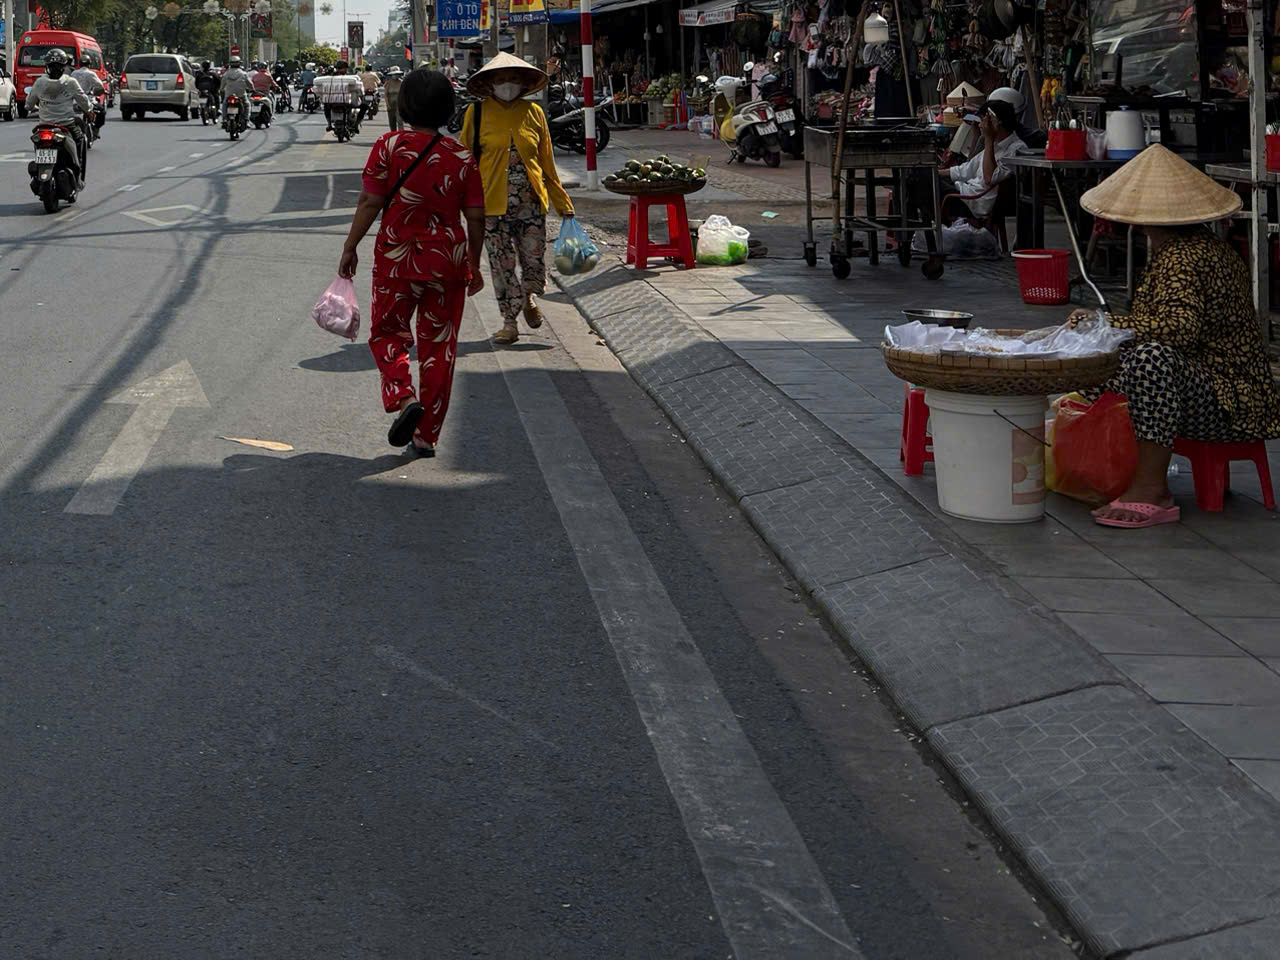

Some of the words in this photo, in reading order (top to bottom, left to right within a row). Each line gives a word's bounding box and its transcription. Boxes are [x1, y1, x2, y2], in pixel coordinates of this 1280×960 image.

[456, 2, 464, 16] Ô
[464, 1, 478, 16] TÔ
[441, 18, 458, 31] KHI
[460, 15, 480, 31] ĐÈN
